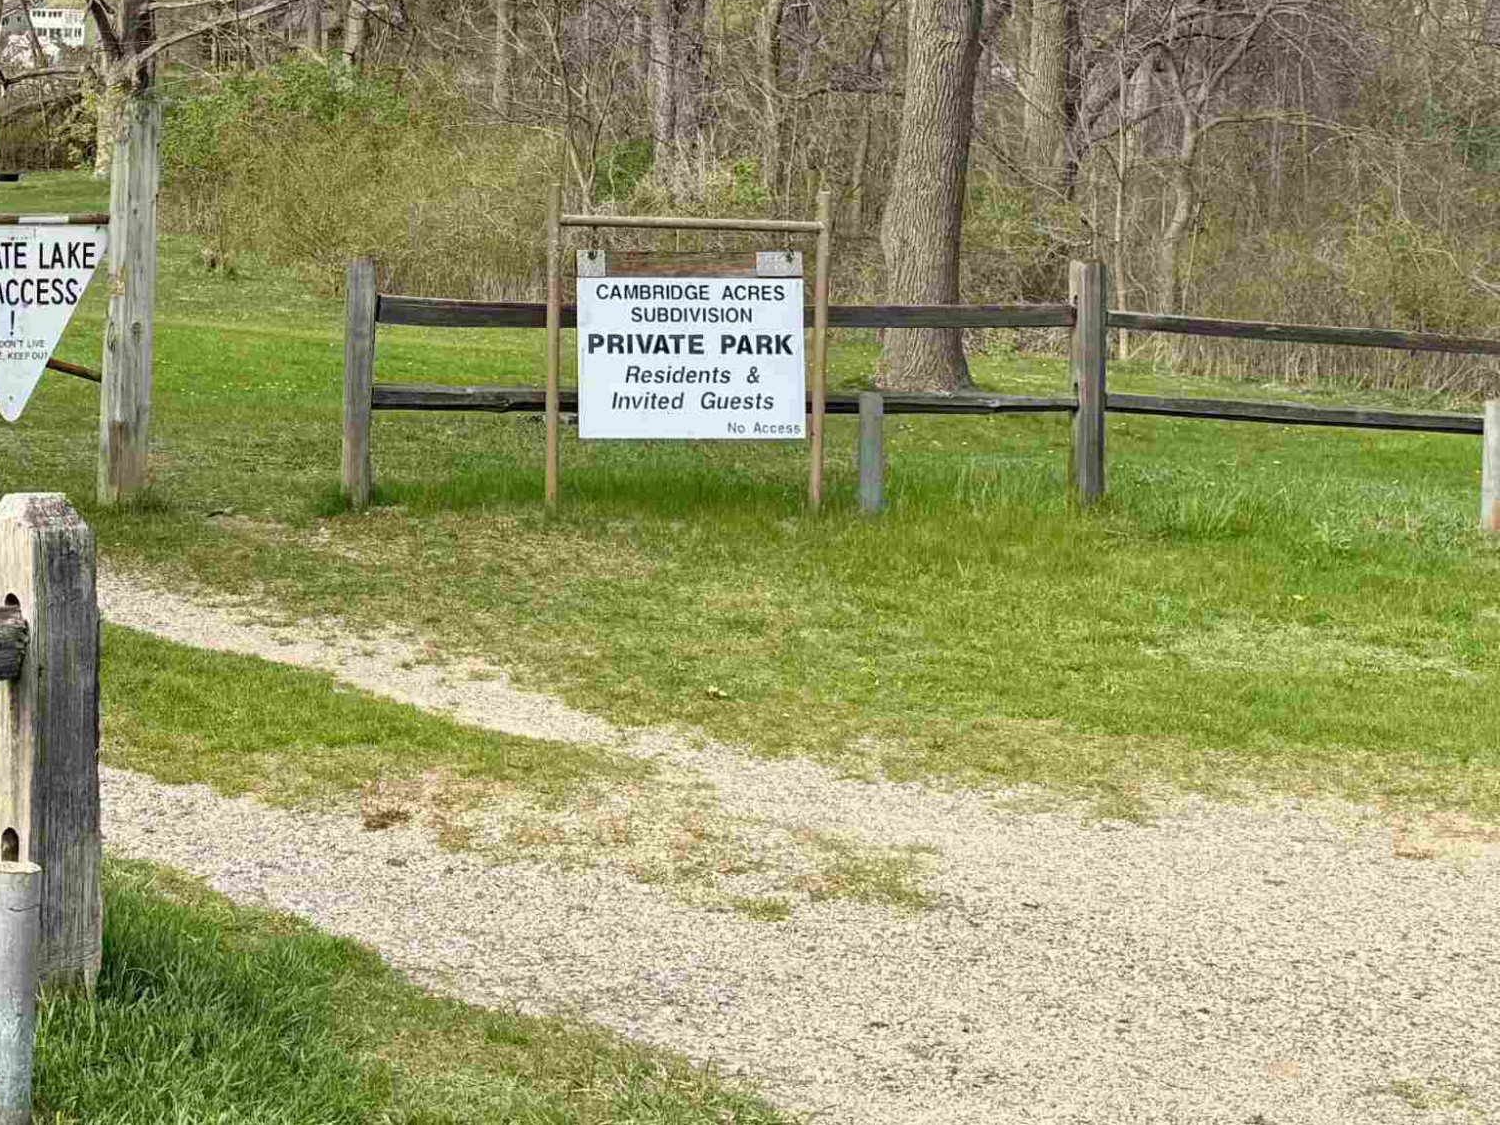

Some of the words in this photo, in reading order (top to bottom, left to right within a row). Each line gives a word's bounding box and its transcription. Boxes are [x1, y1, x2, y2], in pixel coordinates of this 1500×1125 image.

[39, 242, 96, 269] LAKE
[596, 284, 710, 301] CAMBRIDGE
[721, 285, 786, 301] ACRES
[631, 307, 753, 323] SUBDIVISION
[0, 340, 24, 348] DON'T
[27, 340, 45, 348] LIVE
[587, 333, 705, 355] PRIVATE
[721, 334, 794, 355] PARK
[625, 366, 732, 384] Residents
[746, 366, 761, 384] &
[612, 392, 684, 410] Invited
[700, 392, 775, 410] Guests
[727, 422, 745, 434] No
[753, 422, 802, 434] Access
